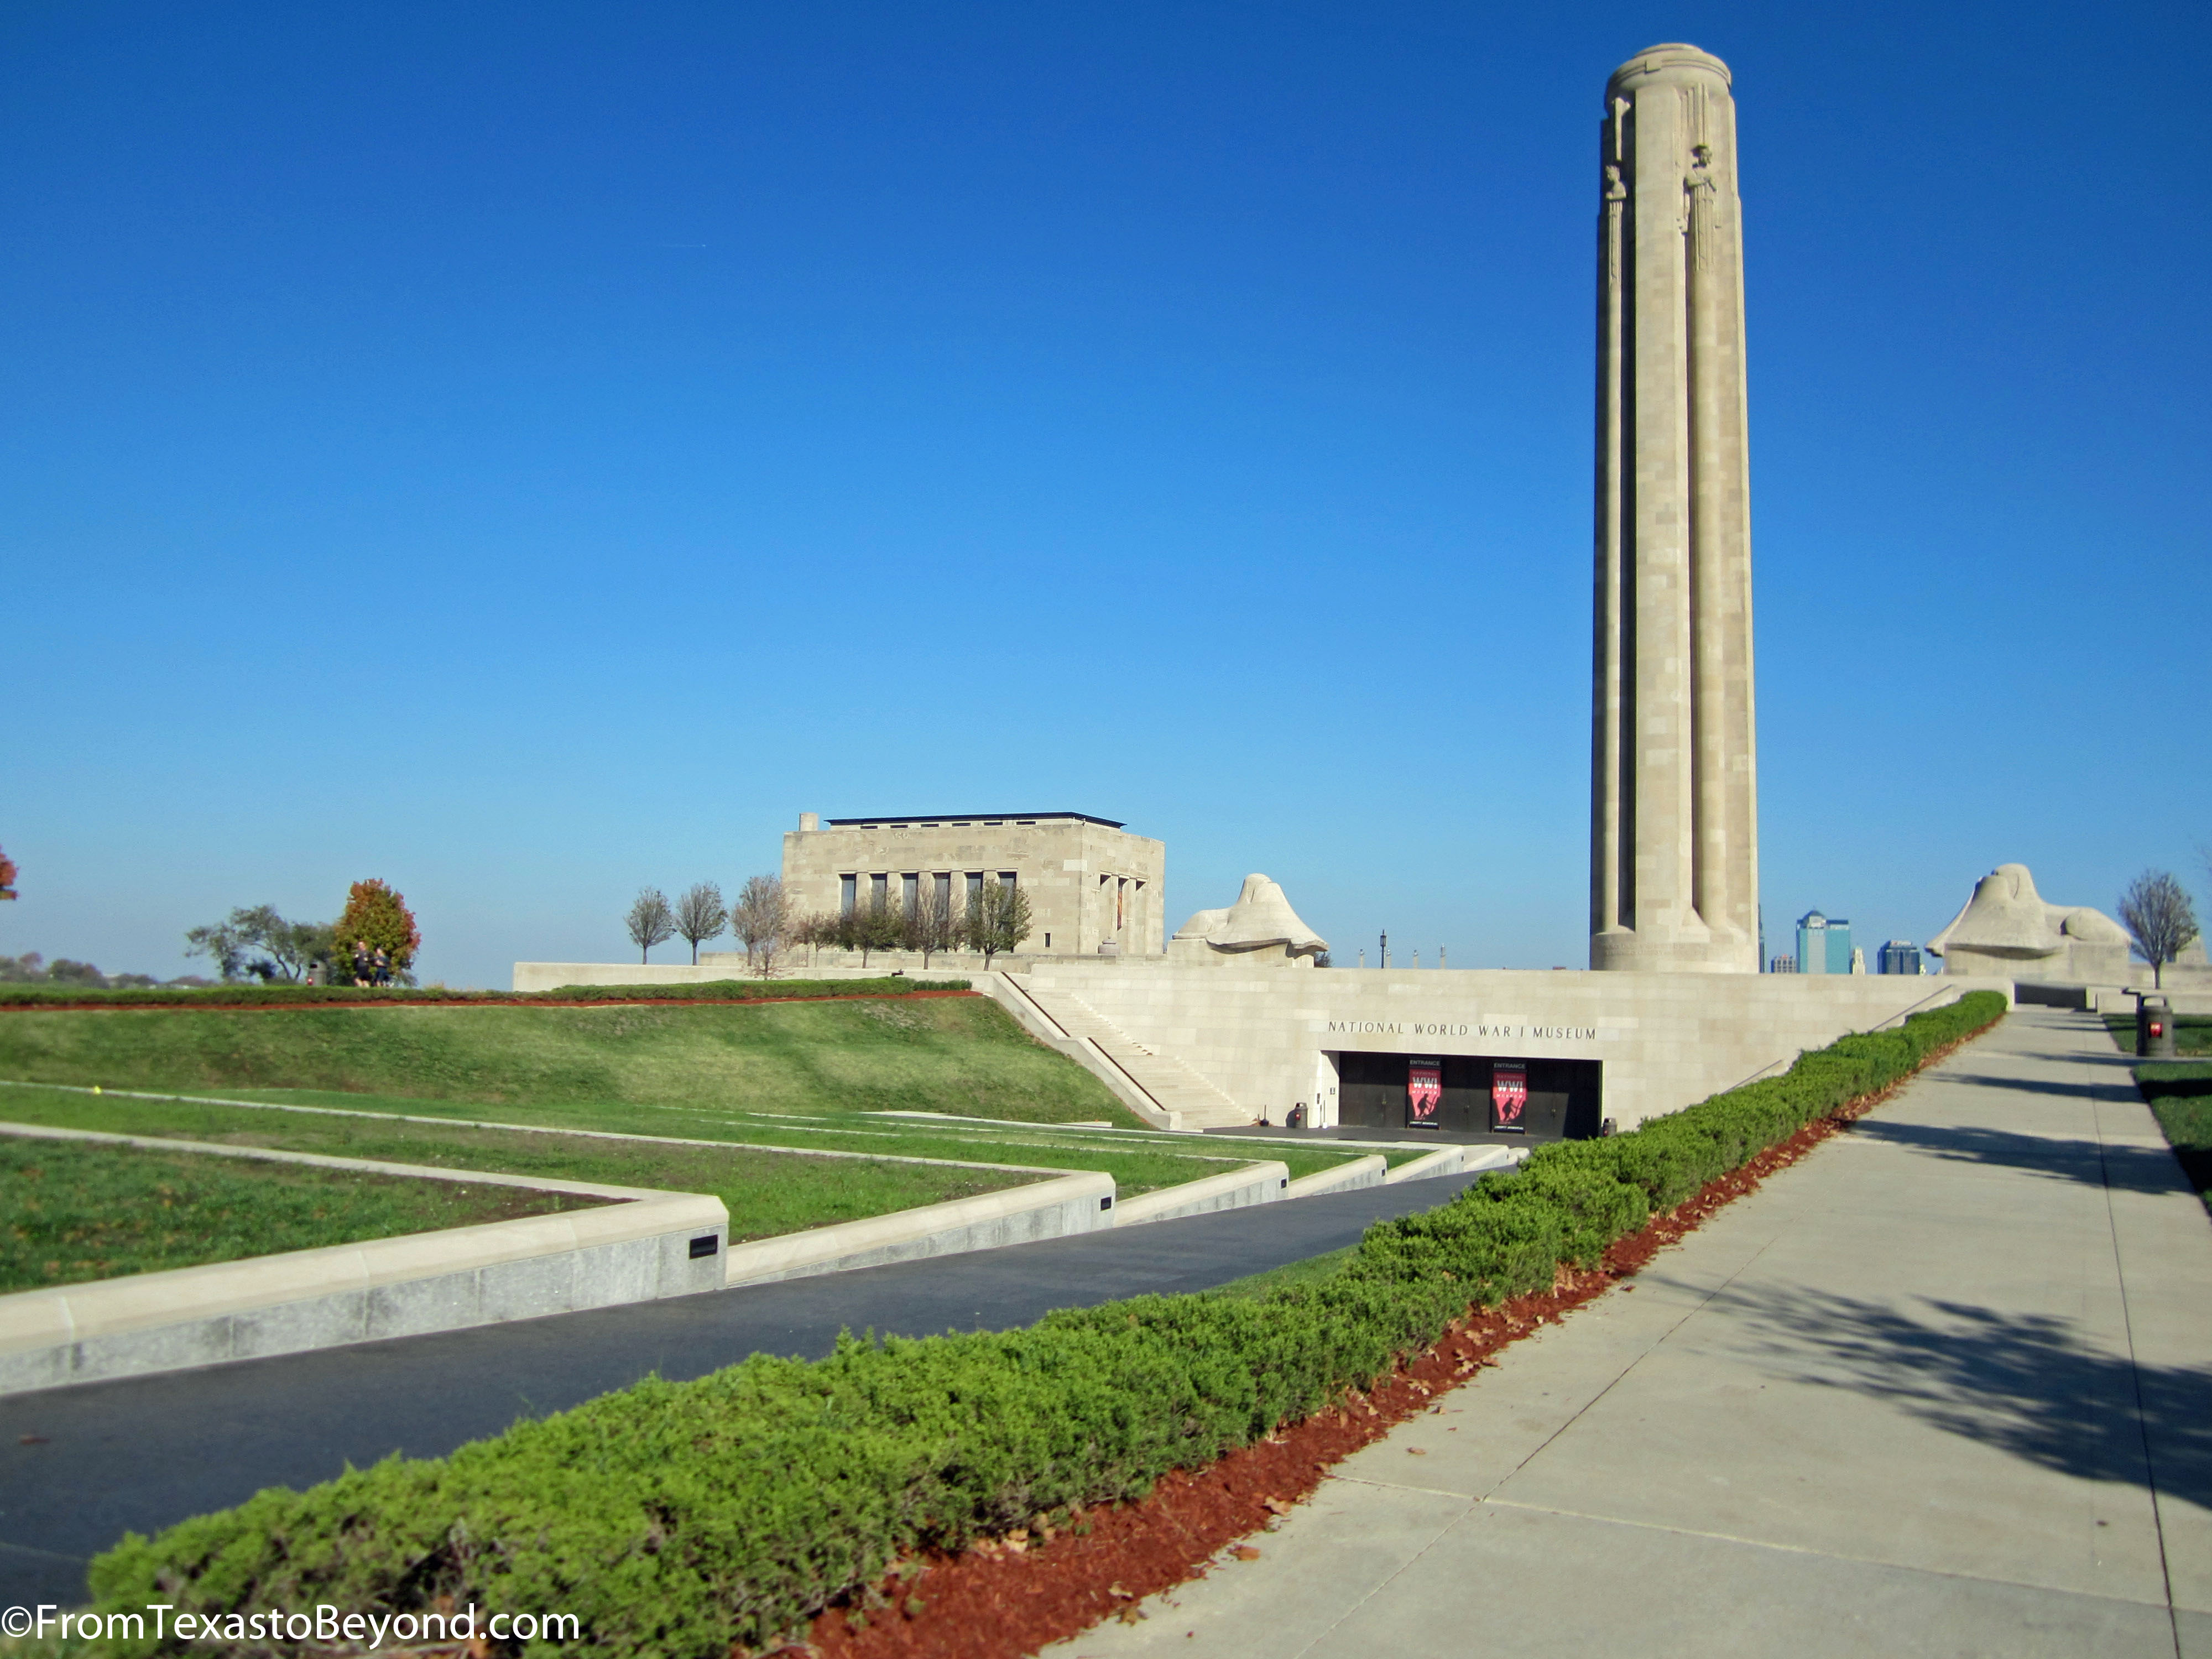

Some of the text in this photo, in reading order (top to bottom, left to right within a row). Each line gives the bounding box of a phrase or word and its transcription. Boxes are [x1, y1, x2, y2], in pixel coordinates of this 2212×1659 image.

[1328, 1021, 1404, 1034] NATIONAL
[1415, 1023, 1468, 1036] WORLD
[1479, 1025, 1510, 1037] WAR
[1533, 1026, 1595, 1040] MUSEUM
[1412, 1077, 1438, 1089] WWI
[1496, 1080, 1522, 1093] WWI
